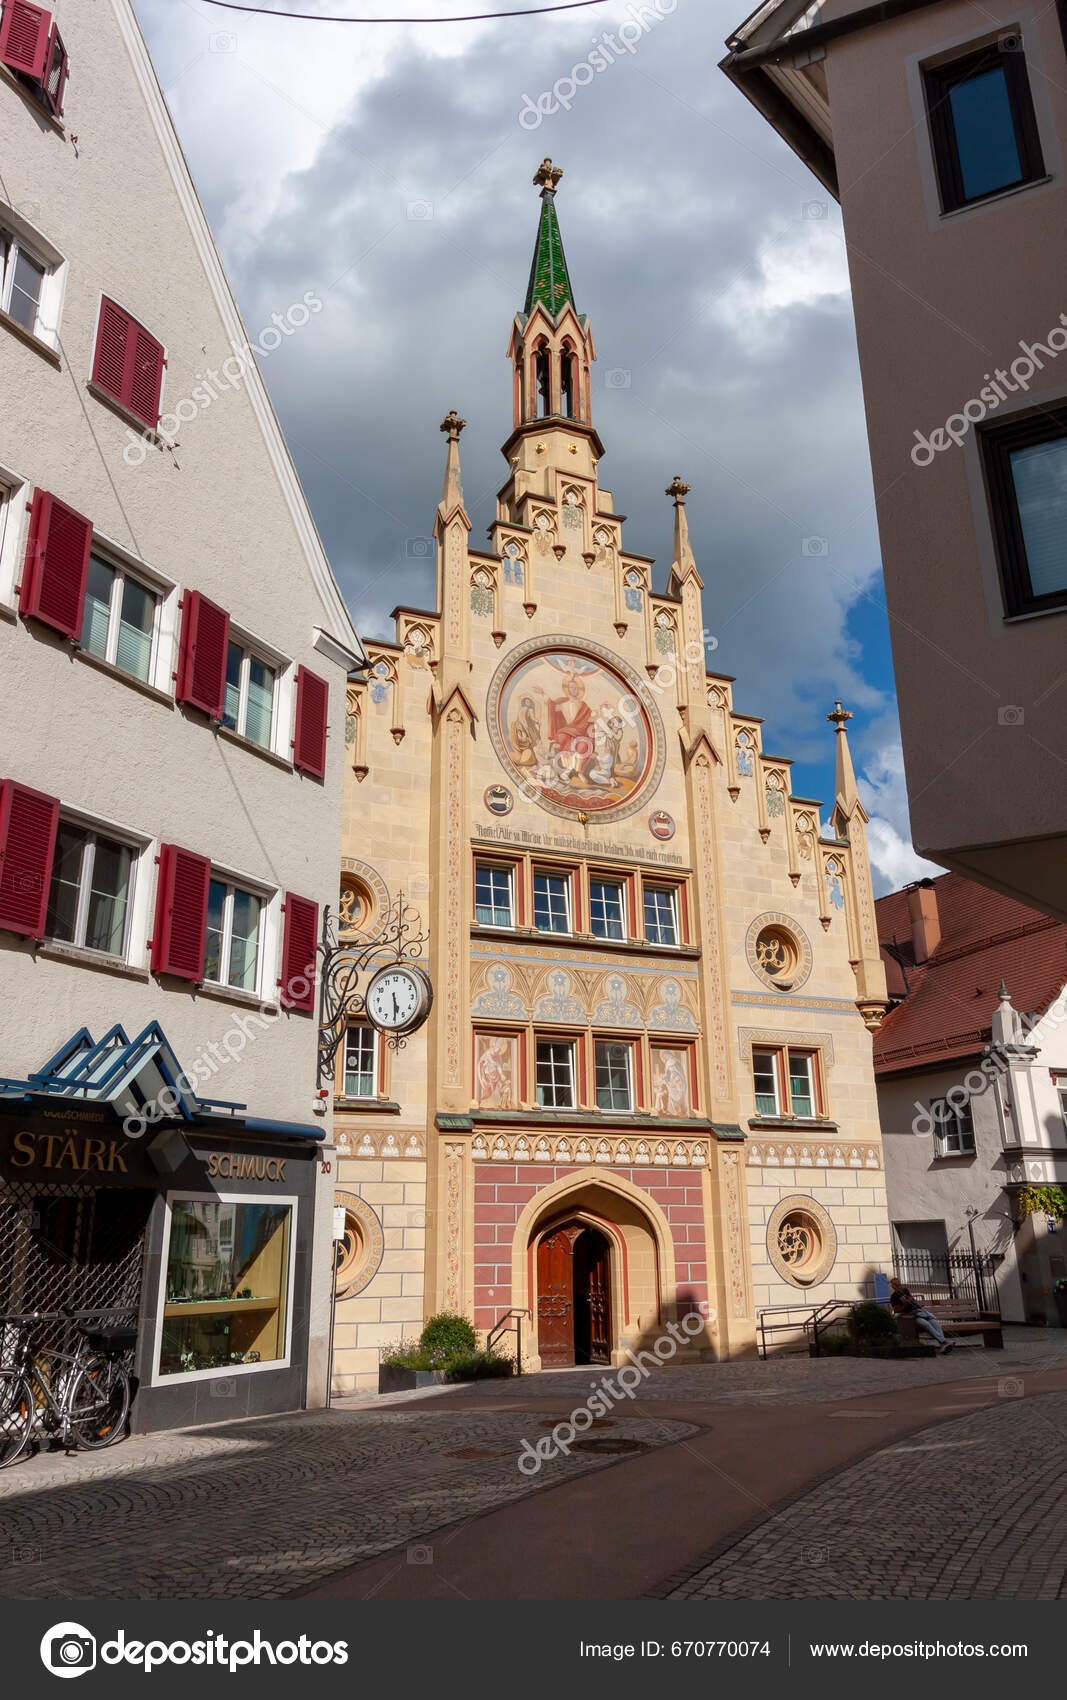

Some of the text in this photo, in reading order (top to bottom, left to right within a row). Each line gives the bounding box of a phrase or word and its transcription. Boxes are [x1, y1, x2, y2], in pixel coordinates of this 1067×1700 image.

[10, 1129, 129, 1173] STÄRK
[208, 1152, 286, 1182] SCHMUCK
[321, 1161, 331, 1174] 20
